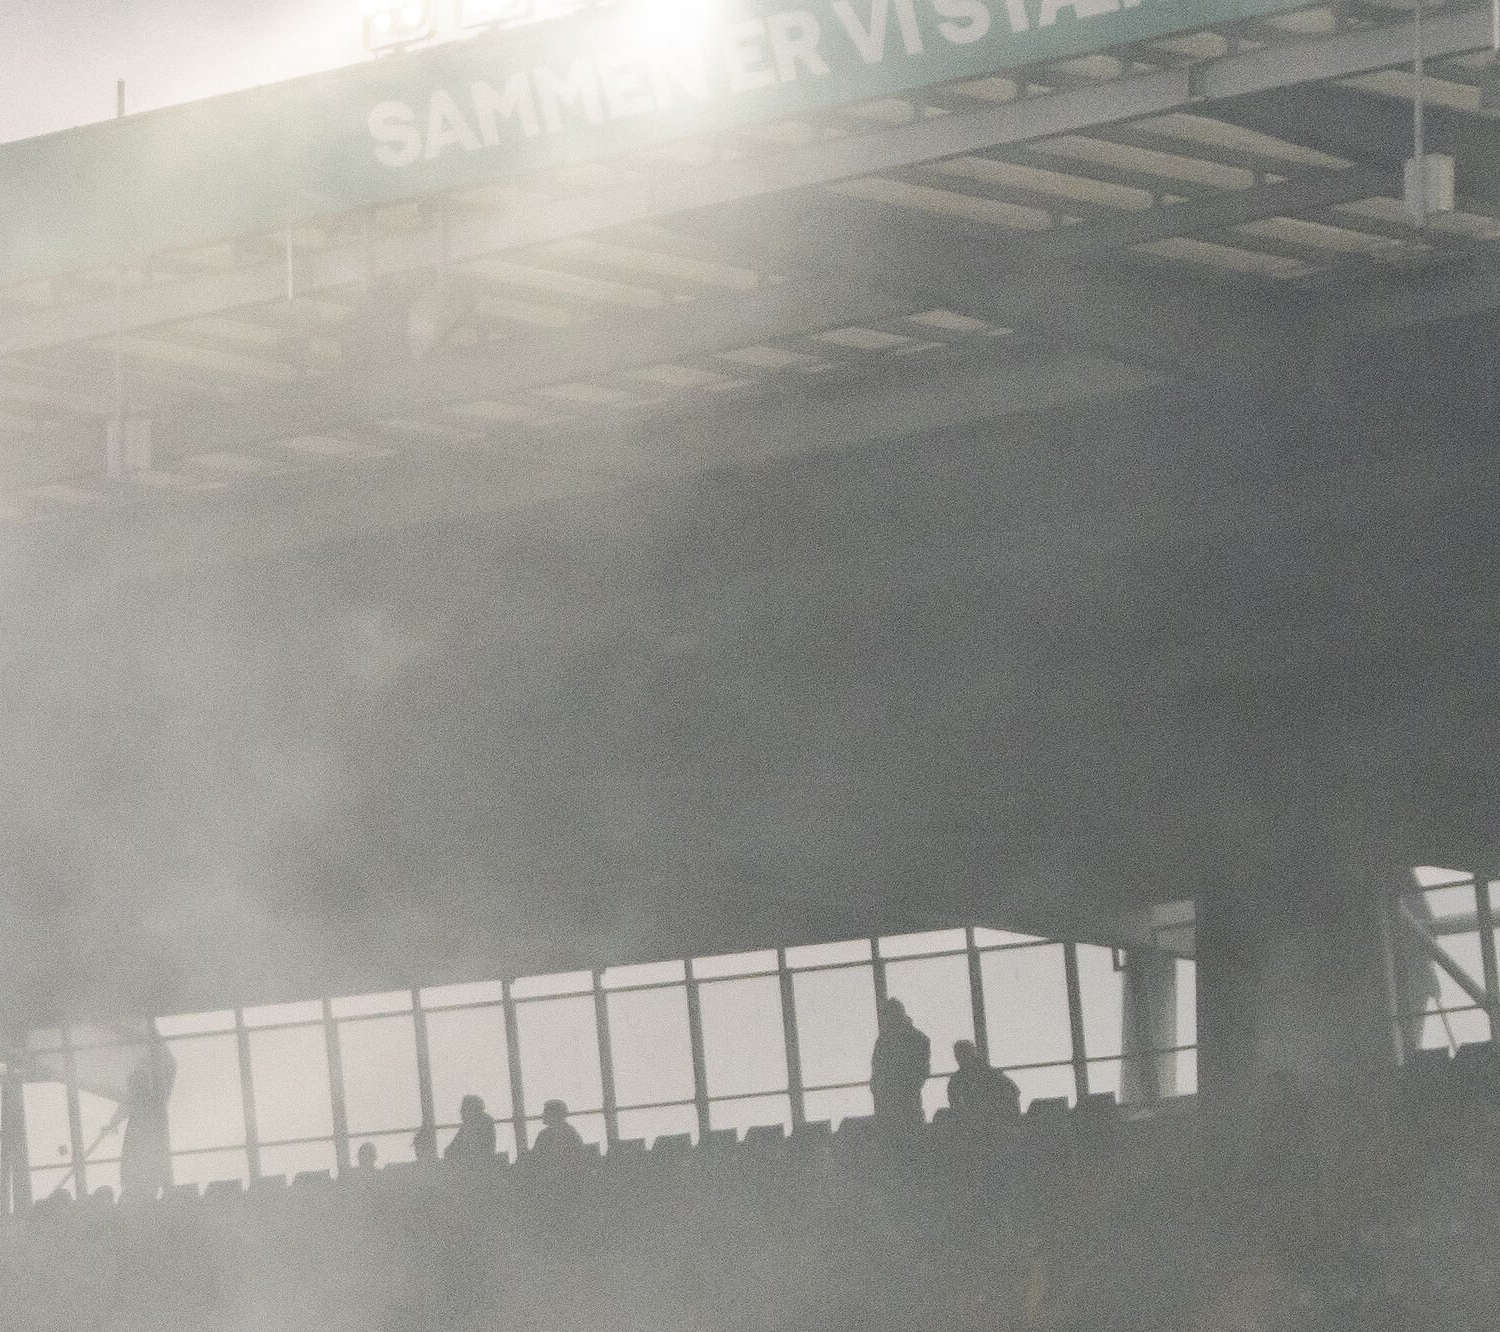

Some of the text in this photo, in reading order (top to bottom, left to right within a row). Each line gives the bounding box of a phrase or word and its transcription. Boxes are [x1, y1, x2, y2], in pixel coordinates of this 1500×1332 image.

[368, 55, 712, 167] SAMMEN
[720, 8, 831, 93] ER
[837, 0, 924, 65] VI
